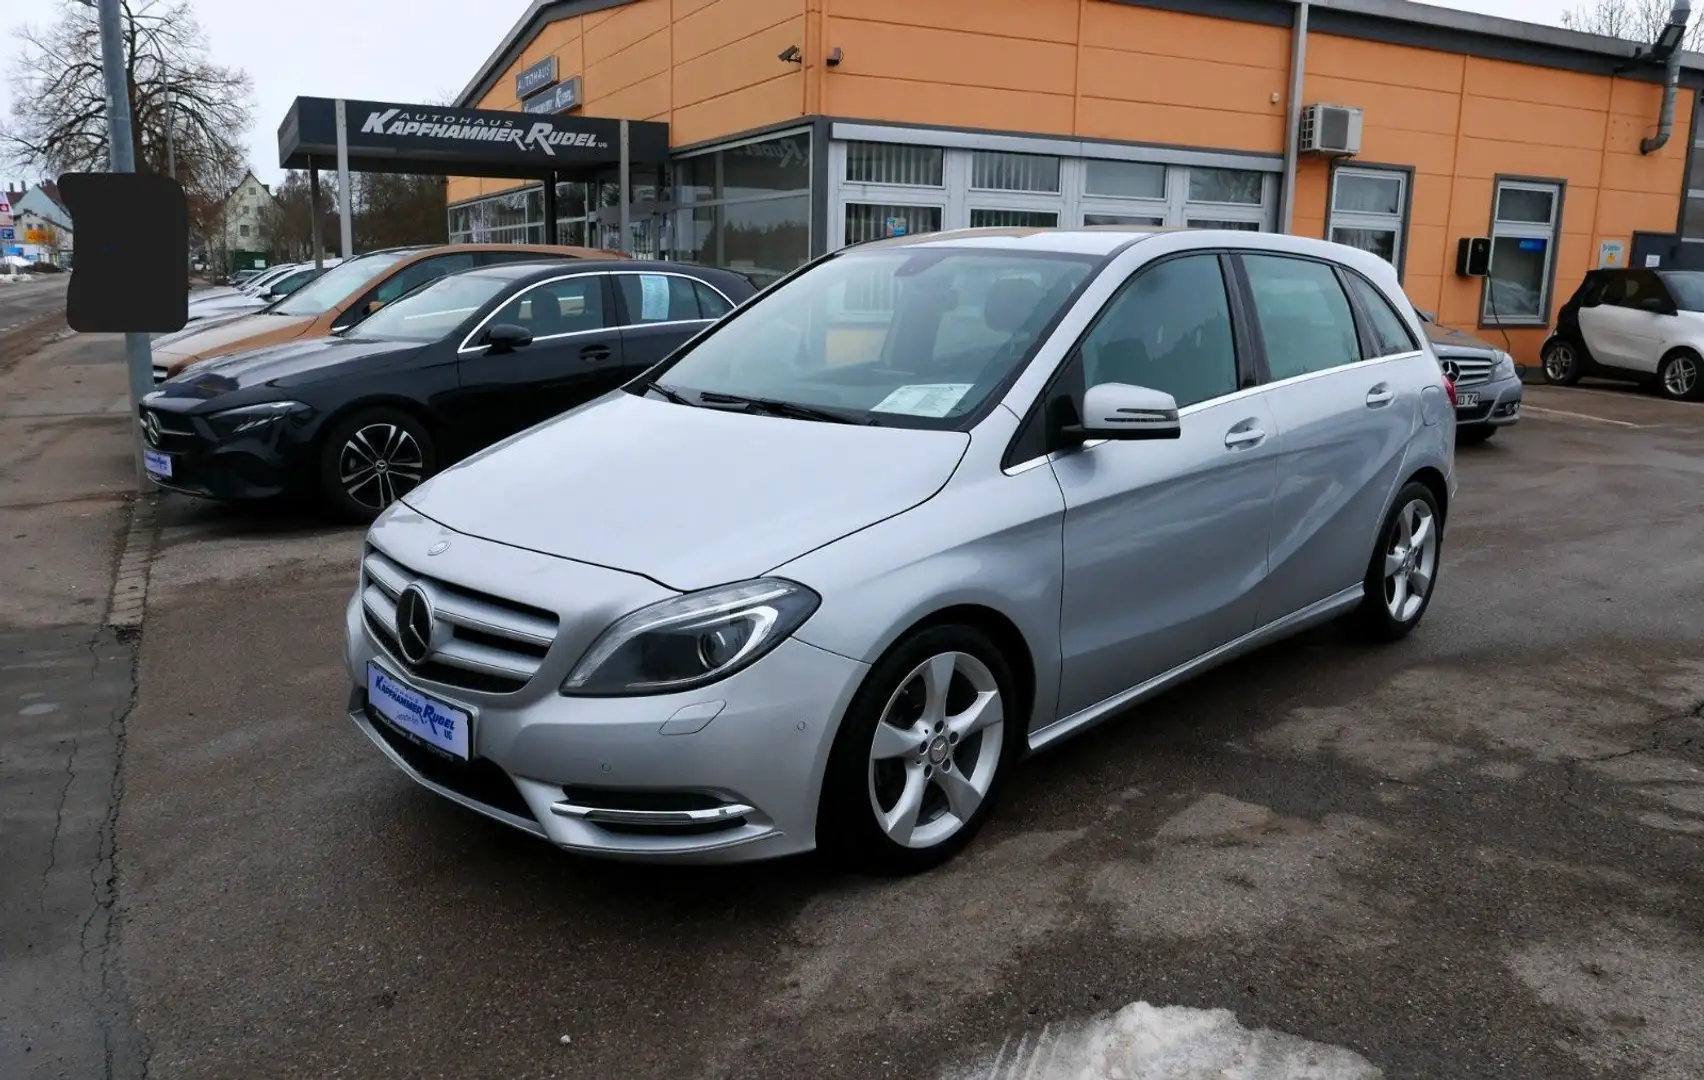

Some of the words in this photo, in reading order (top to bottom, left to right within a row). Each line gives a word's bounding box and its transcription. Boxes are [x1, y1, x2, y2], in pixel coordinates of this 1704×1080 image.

[361, 108, 527, 151] KAPFHAMMER
[524, 122, 597, 156] RUDEL
[398, 112, 514, 127] AUTOHAUS
[375, 675, 425, 725] KAPFHAMMER
[423, 704, 455, 736] RUDEL
[444, 728, 453, 741] UG
